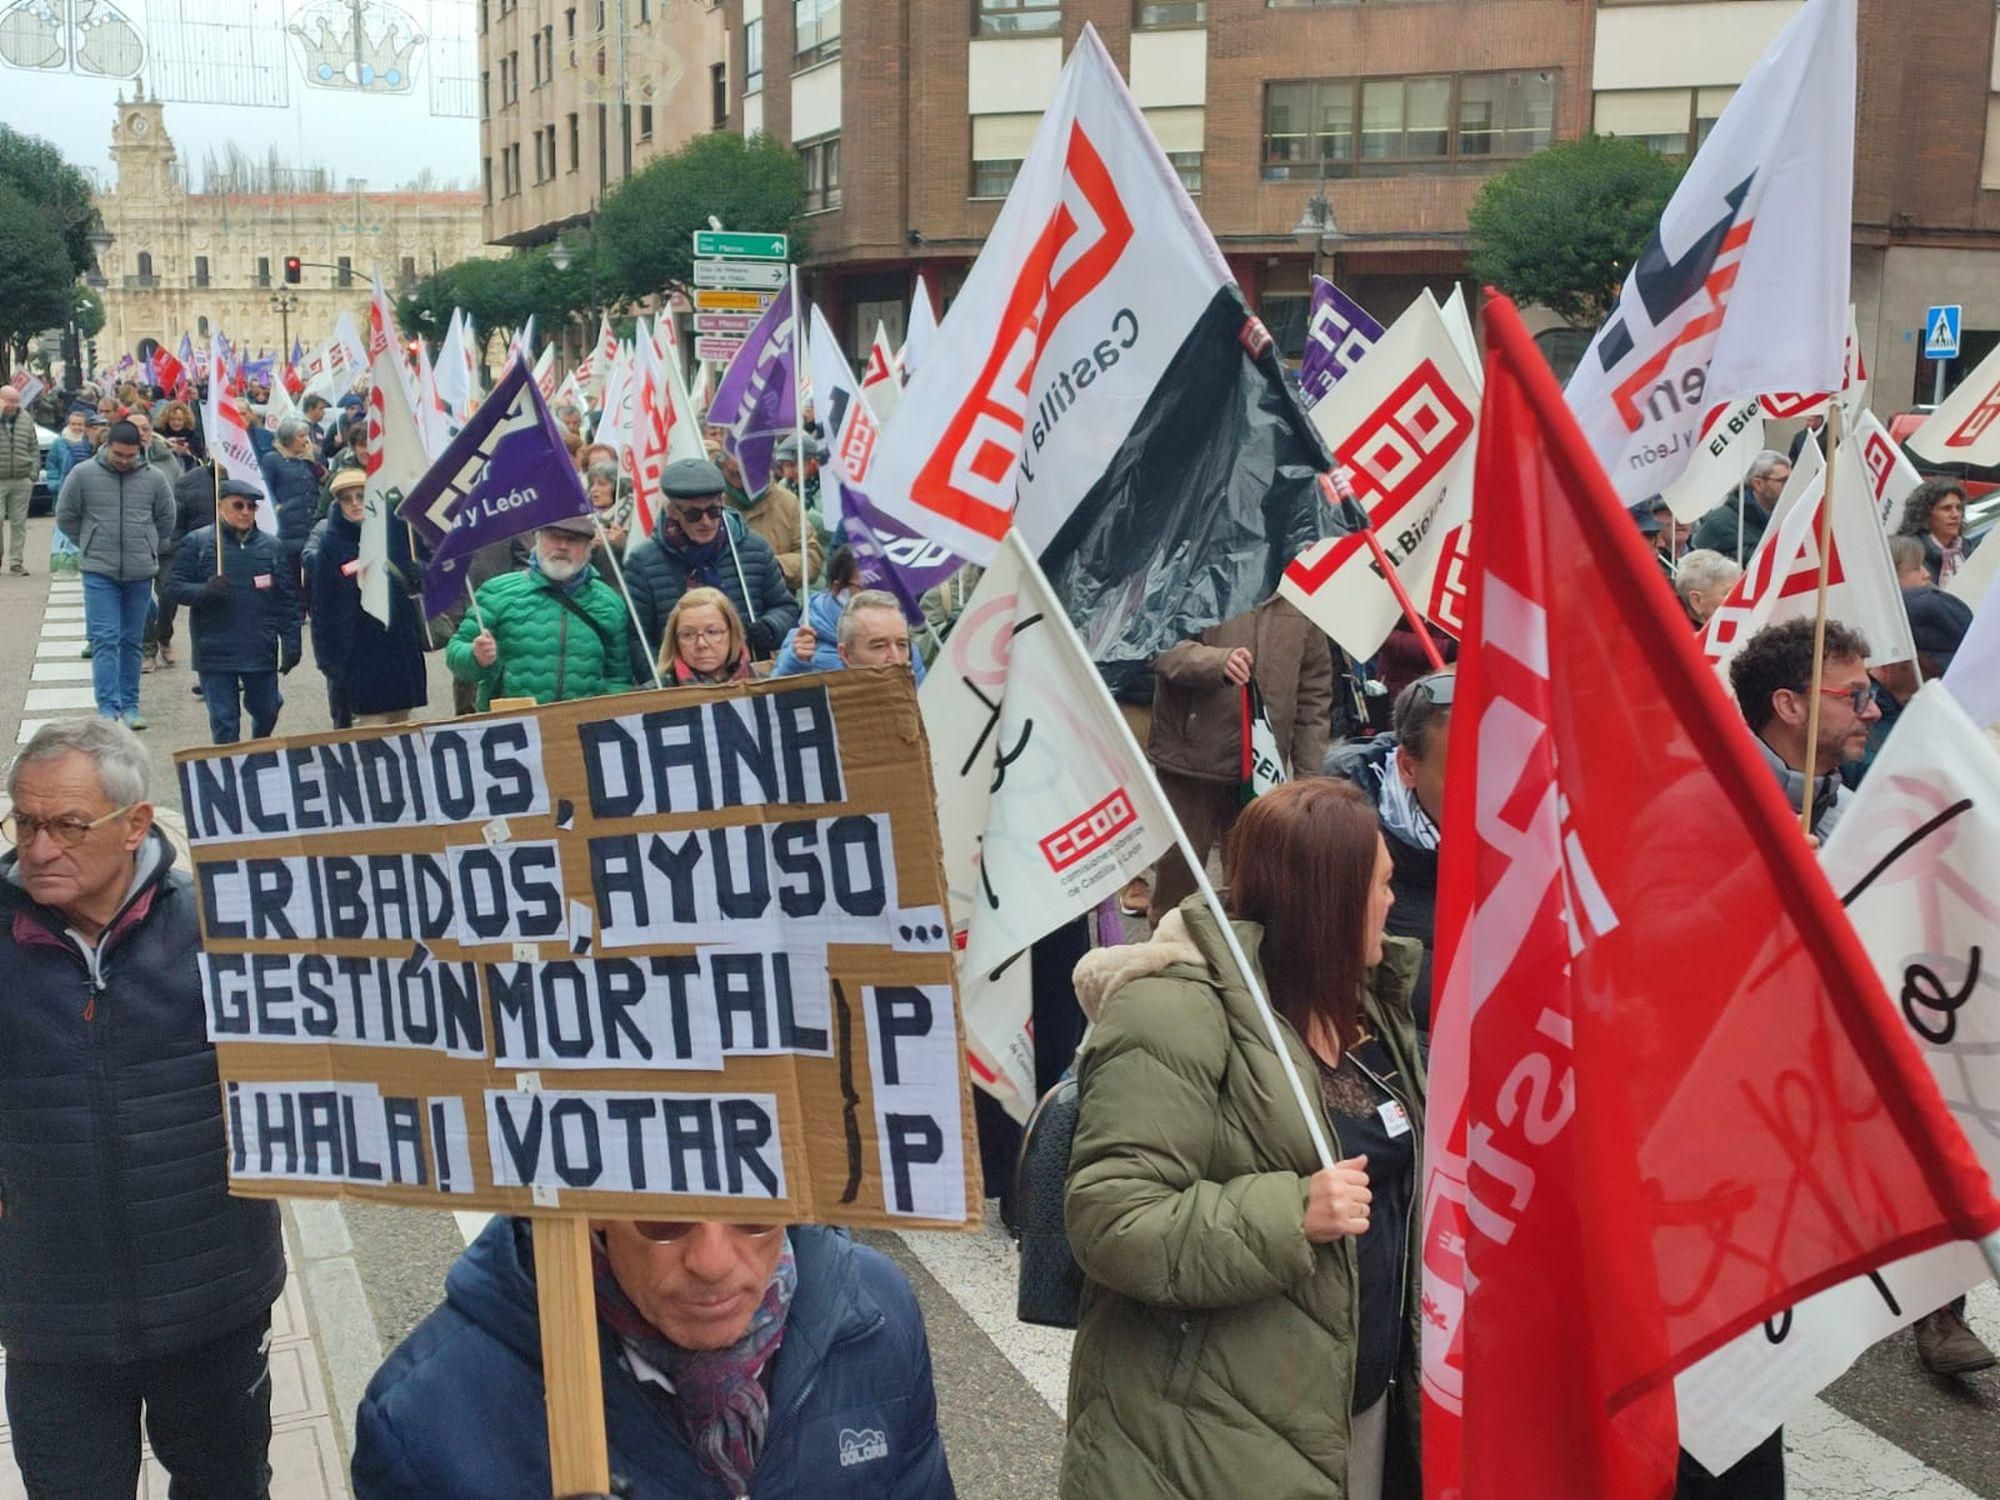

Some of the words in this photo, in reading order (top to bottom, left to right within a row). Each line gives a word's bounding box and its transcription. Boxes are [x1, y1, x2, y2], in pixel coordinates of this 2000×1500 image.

[1709, 433, 1730, 458] El
[482, 486, 539, 517] León
[577, 685, 843, 819] DANA
[1045, 795, 1131, 863] CCOO
[196, 846, 593, 954] CRIBADOS,
[587, 814, 944, 941] AYUSO...
[206, 941, 485, 1053] GESTIÓN
[485, 951, 829, 1061] MORTAL
[873, 985, 933, 1086] P
[226, 1081, 451, 1193] ¡HALA!
[494, 1094, 779, 1198] VOTAR
[885, 1112, 944, 1213] P
